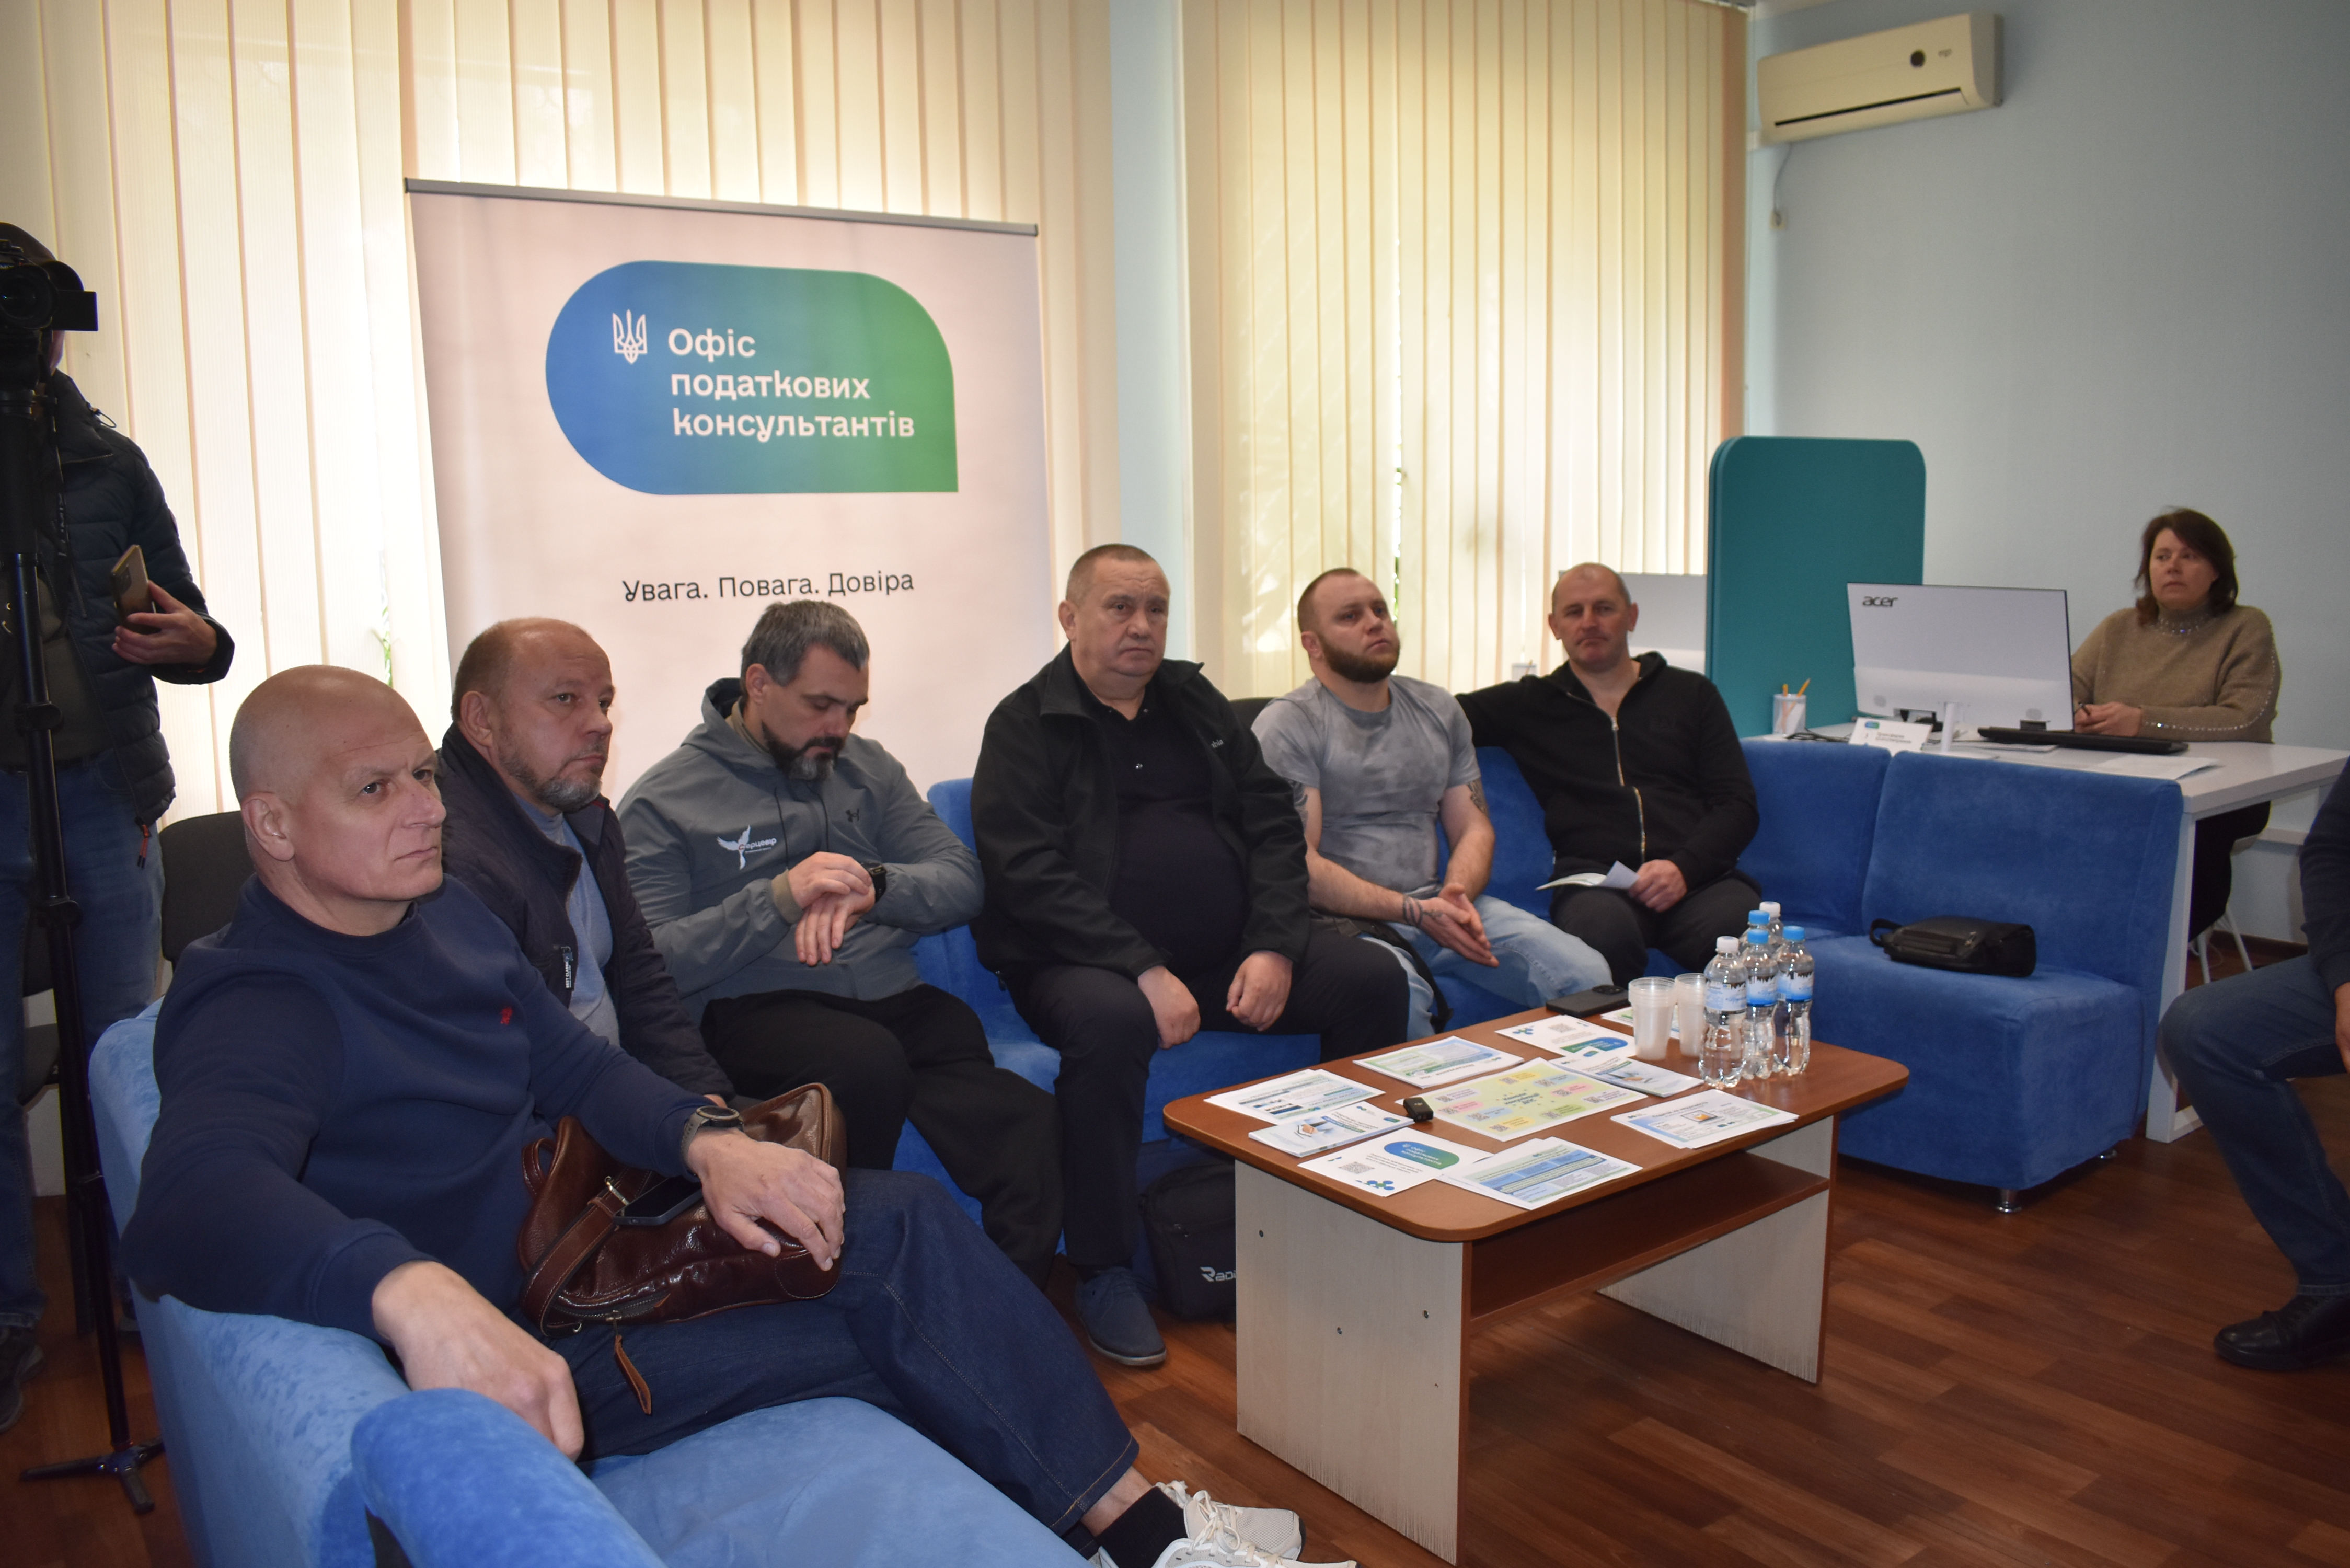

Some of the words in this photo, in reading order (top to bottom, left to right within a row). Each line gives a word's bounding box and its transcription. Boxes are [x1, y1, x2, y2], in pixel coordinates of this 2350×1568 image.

[667, 327, 757, 362] Офіс
[671, 370, 870, 400] податкових
[673, 408, 915, 443] консультантів
[622, 579, 709, 602] Увага.
[719, 576, 819, 598] Повага.
[828, 570, 914, 597] Довіра
[1862, 596, 1898, 607] acer
